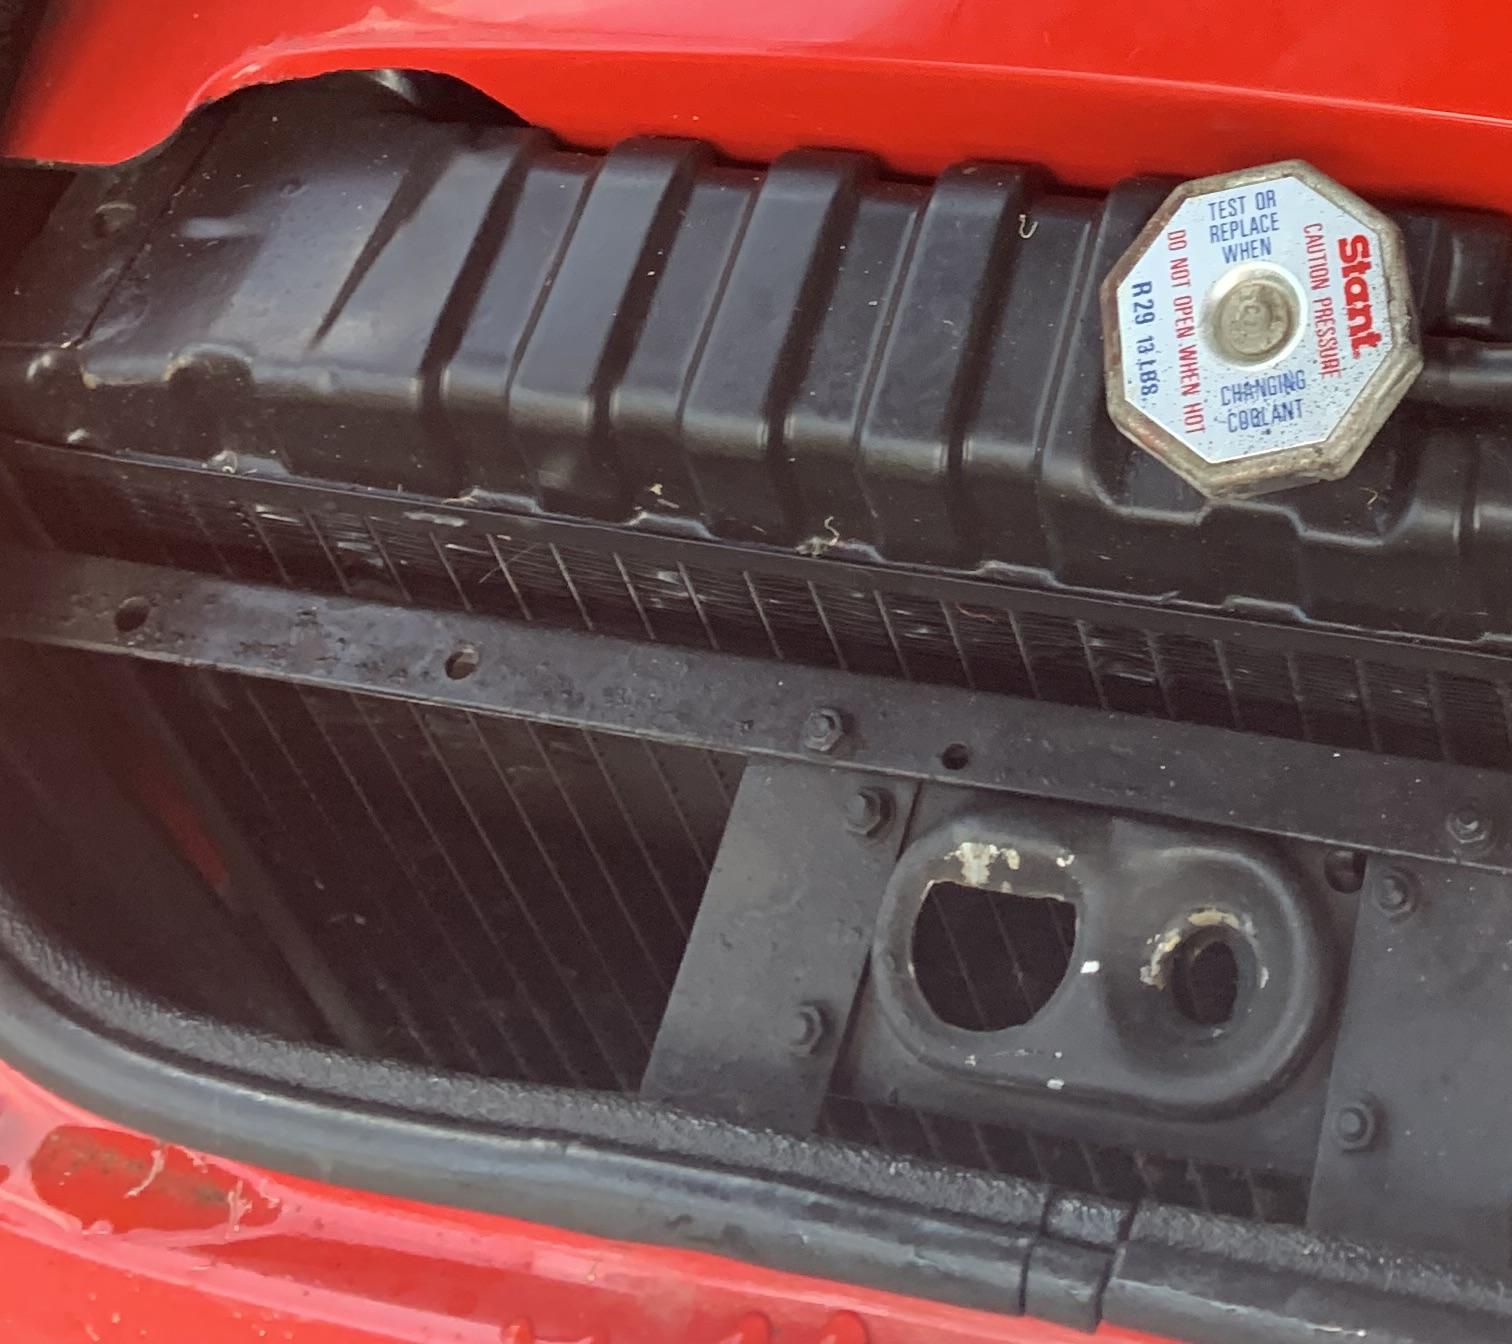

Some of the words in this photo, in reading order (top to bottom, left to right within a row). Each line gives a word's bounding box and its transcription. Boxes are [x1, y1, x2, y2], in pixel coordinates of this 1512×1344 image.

[1207, 195, 1247, 221] TEST
[1255, 189, 1278, 211] OR
[1167, 229, 1187, 251] DO
[1209, 212, 1280, 244] REPLACE
[1221, 238, 1273, 264] WHEN
[1303, 223, 1331, 291] CAUTION
[1169, 257, 1191, 288] NOT
[1337, 234, 1383, 353] Stant
[1173, 295, 1196, 339] OPEN
[1313, 297, 1342, 379] PRESSURE
[1178, 344, 1201, 396] WHEN
[1220, 369, 1307, 406] CHANGING
[1182, 402, 1206, 433] HOT
[1227, 398, 1304, 433] COOLANT
